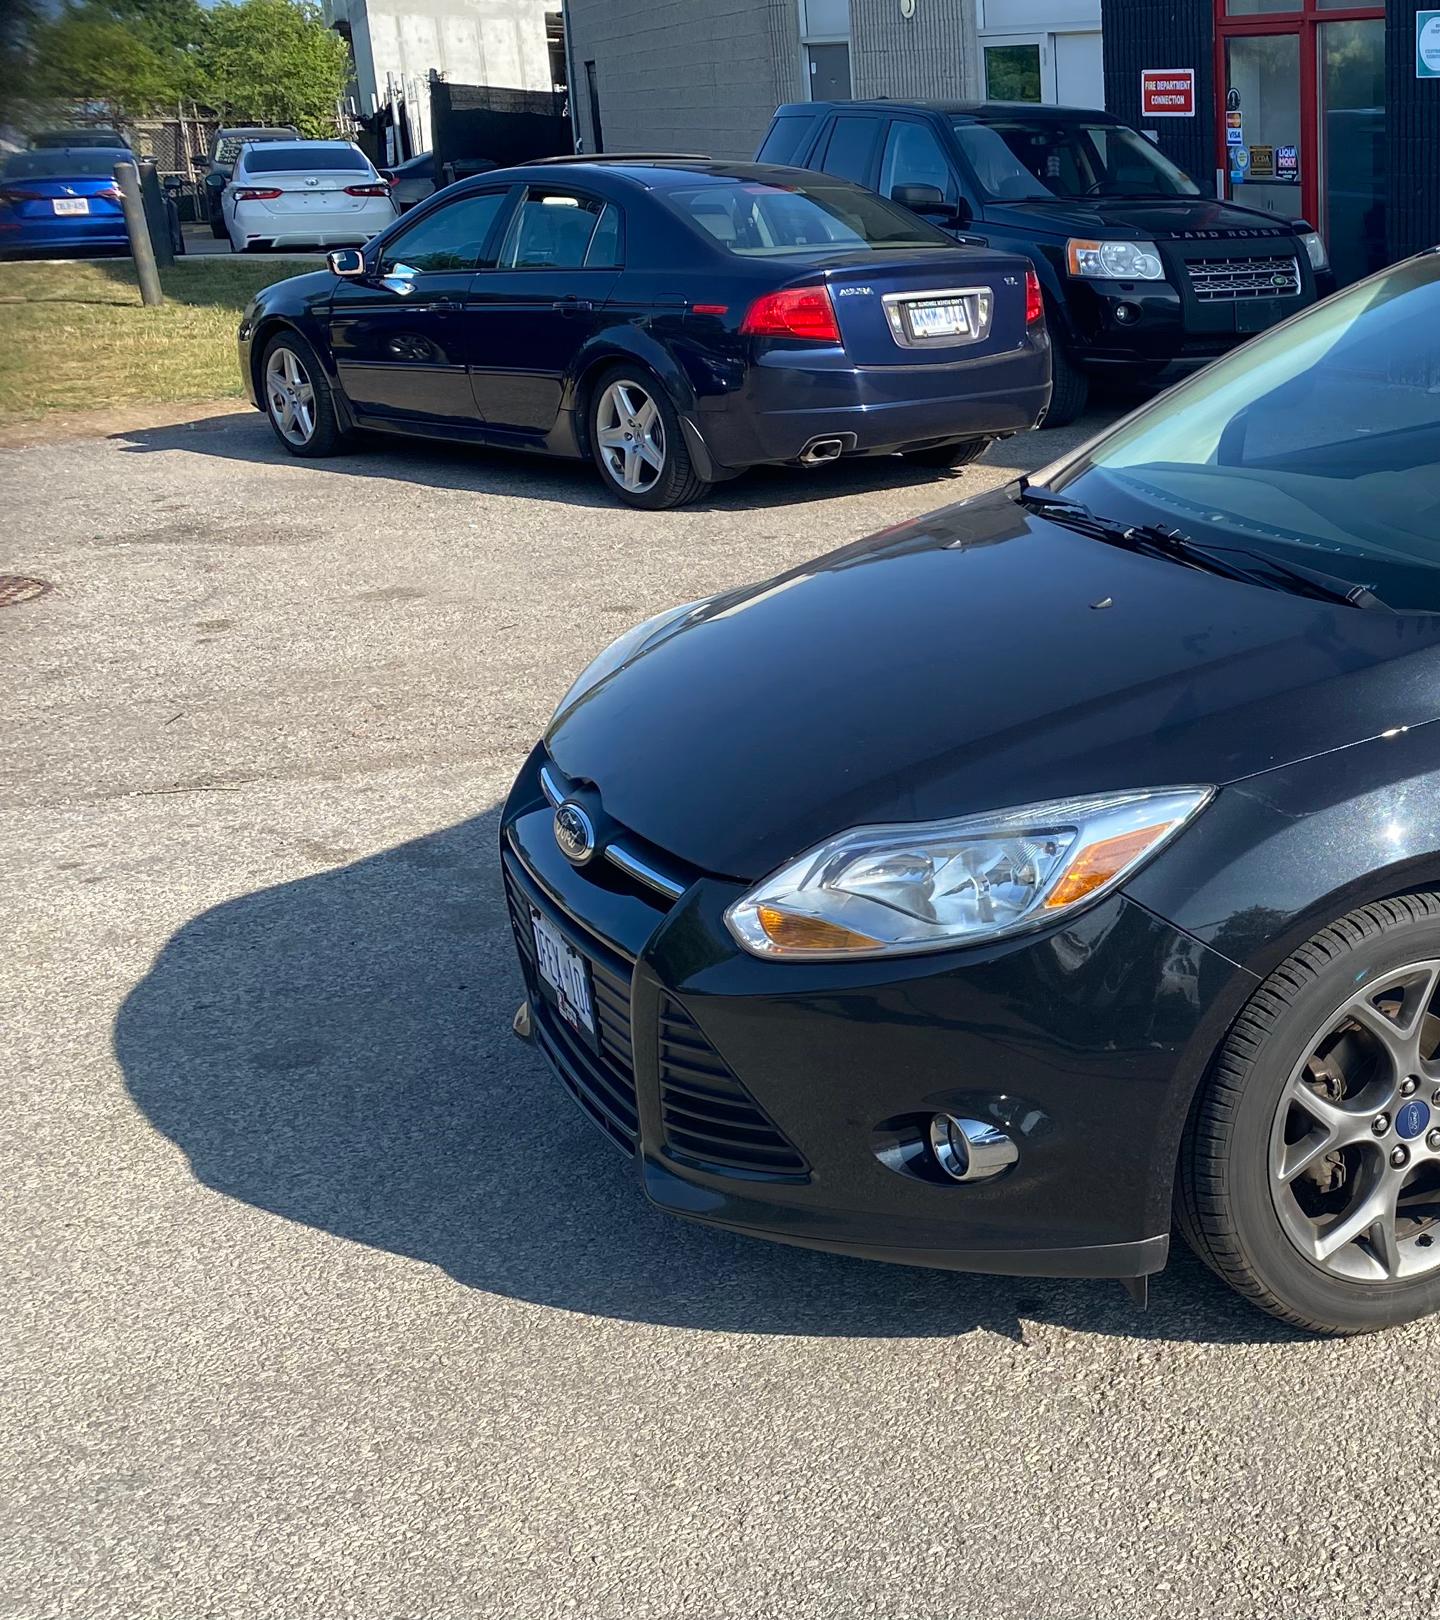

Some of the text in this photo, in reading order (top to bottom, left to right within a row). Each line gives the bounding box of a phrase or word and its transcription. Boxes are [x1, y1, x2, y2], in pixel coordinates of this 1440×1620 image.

[1145, 80, 1191, 90] FIRE DEPARTMENT
[1151, 95, 1185, 105] CONNECTION
[1229, 130, 1241, 139] VISA
[1278, 147, 1296, 157] LIQUI
[1278, 157, 1296, 166] MOLY
[1171, 229, 1281, 239] LAND ROVER
